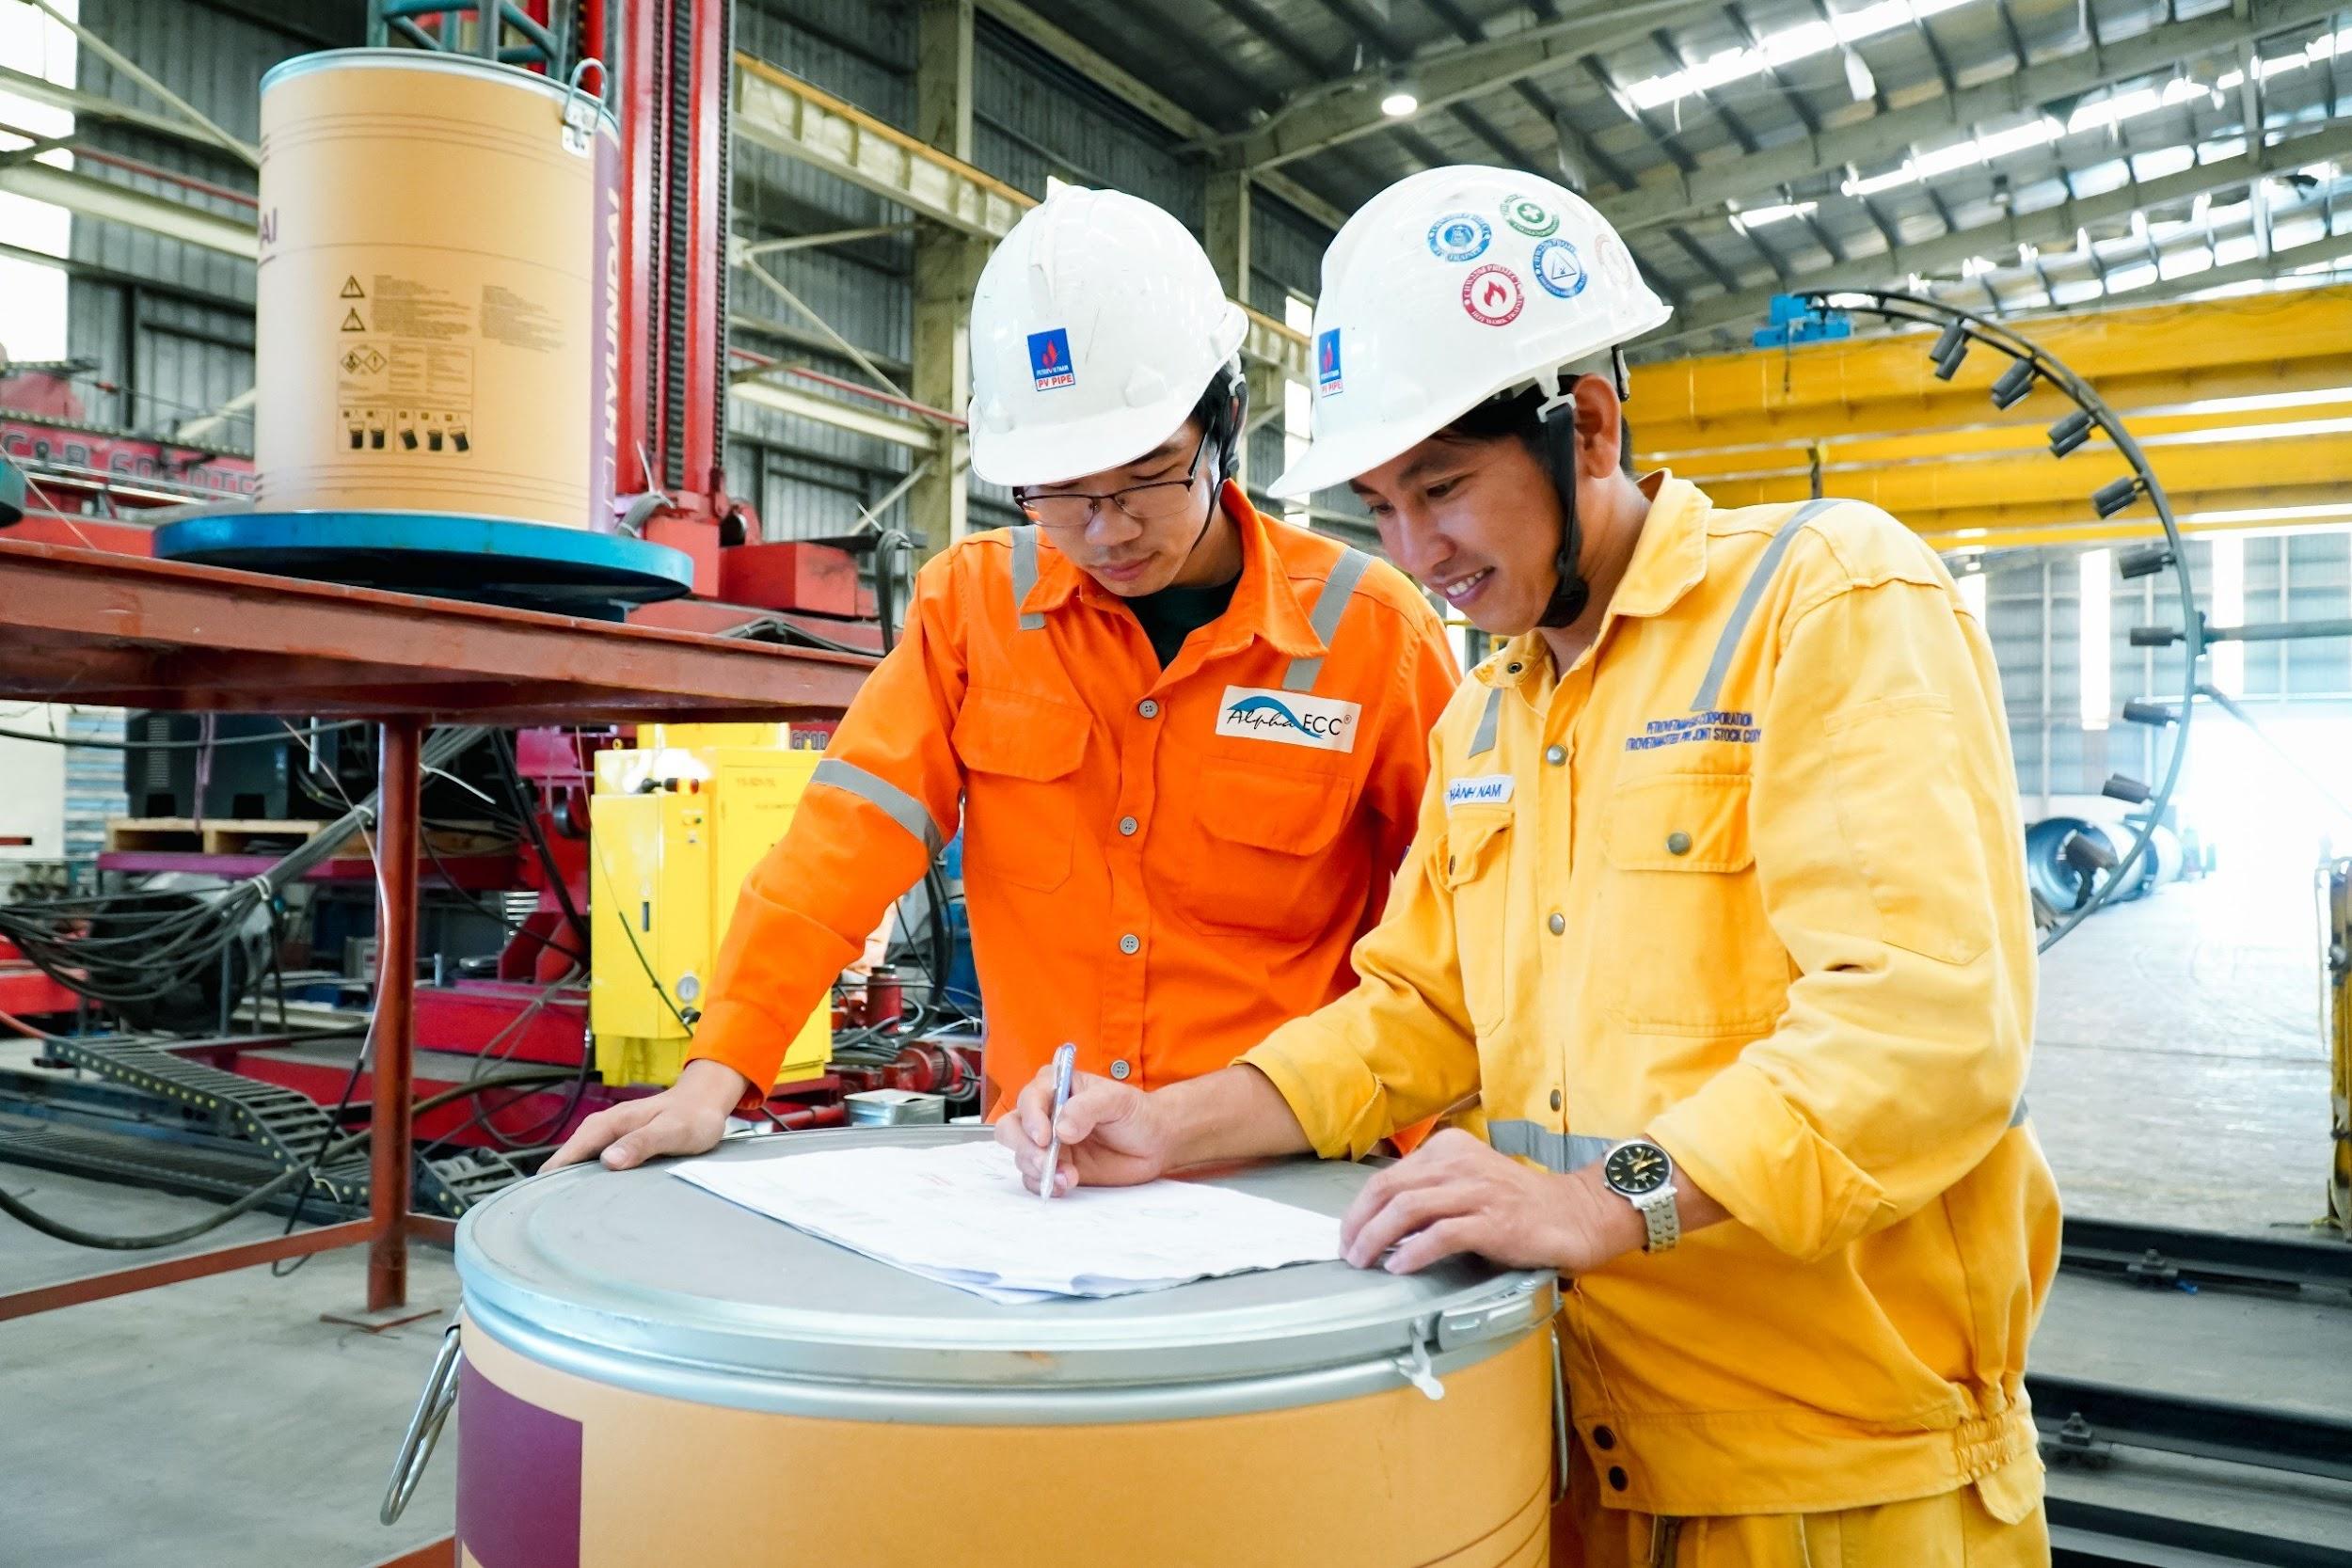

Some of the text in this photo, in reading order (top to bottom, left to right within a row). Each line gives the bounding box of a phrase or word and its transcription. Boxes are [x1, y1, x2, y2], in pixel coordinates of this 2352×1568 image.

[604, 186, 620, 448] HYUNDAI
[1038, 373, 1073, 388] PV PIPE
[1227, 709, 1295, 729] Alpha
[1713, 728, 1741, 742] STOCK
[1476, 784, 1502, 799] NAM
